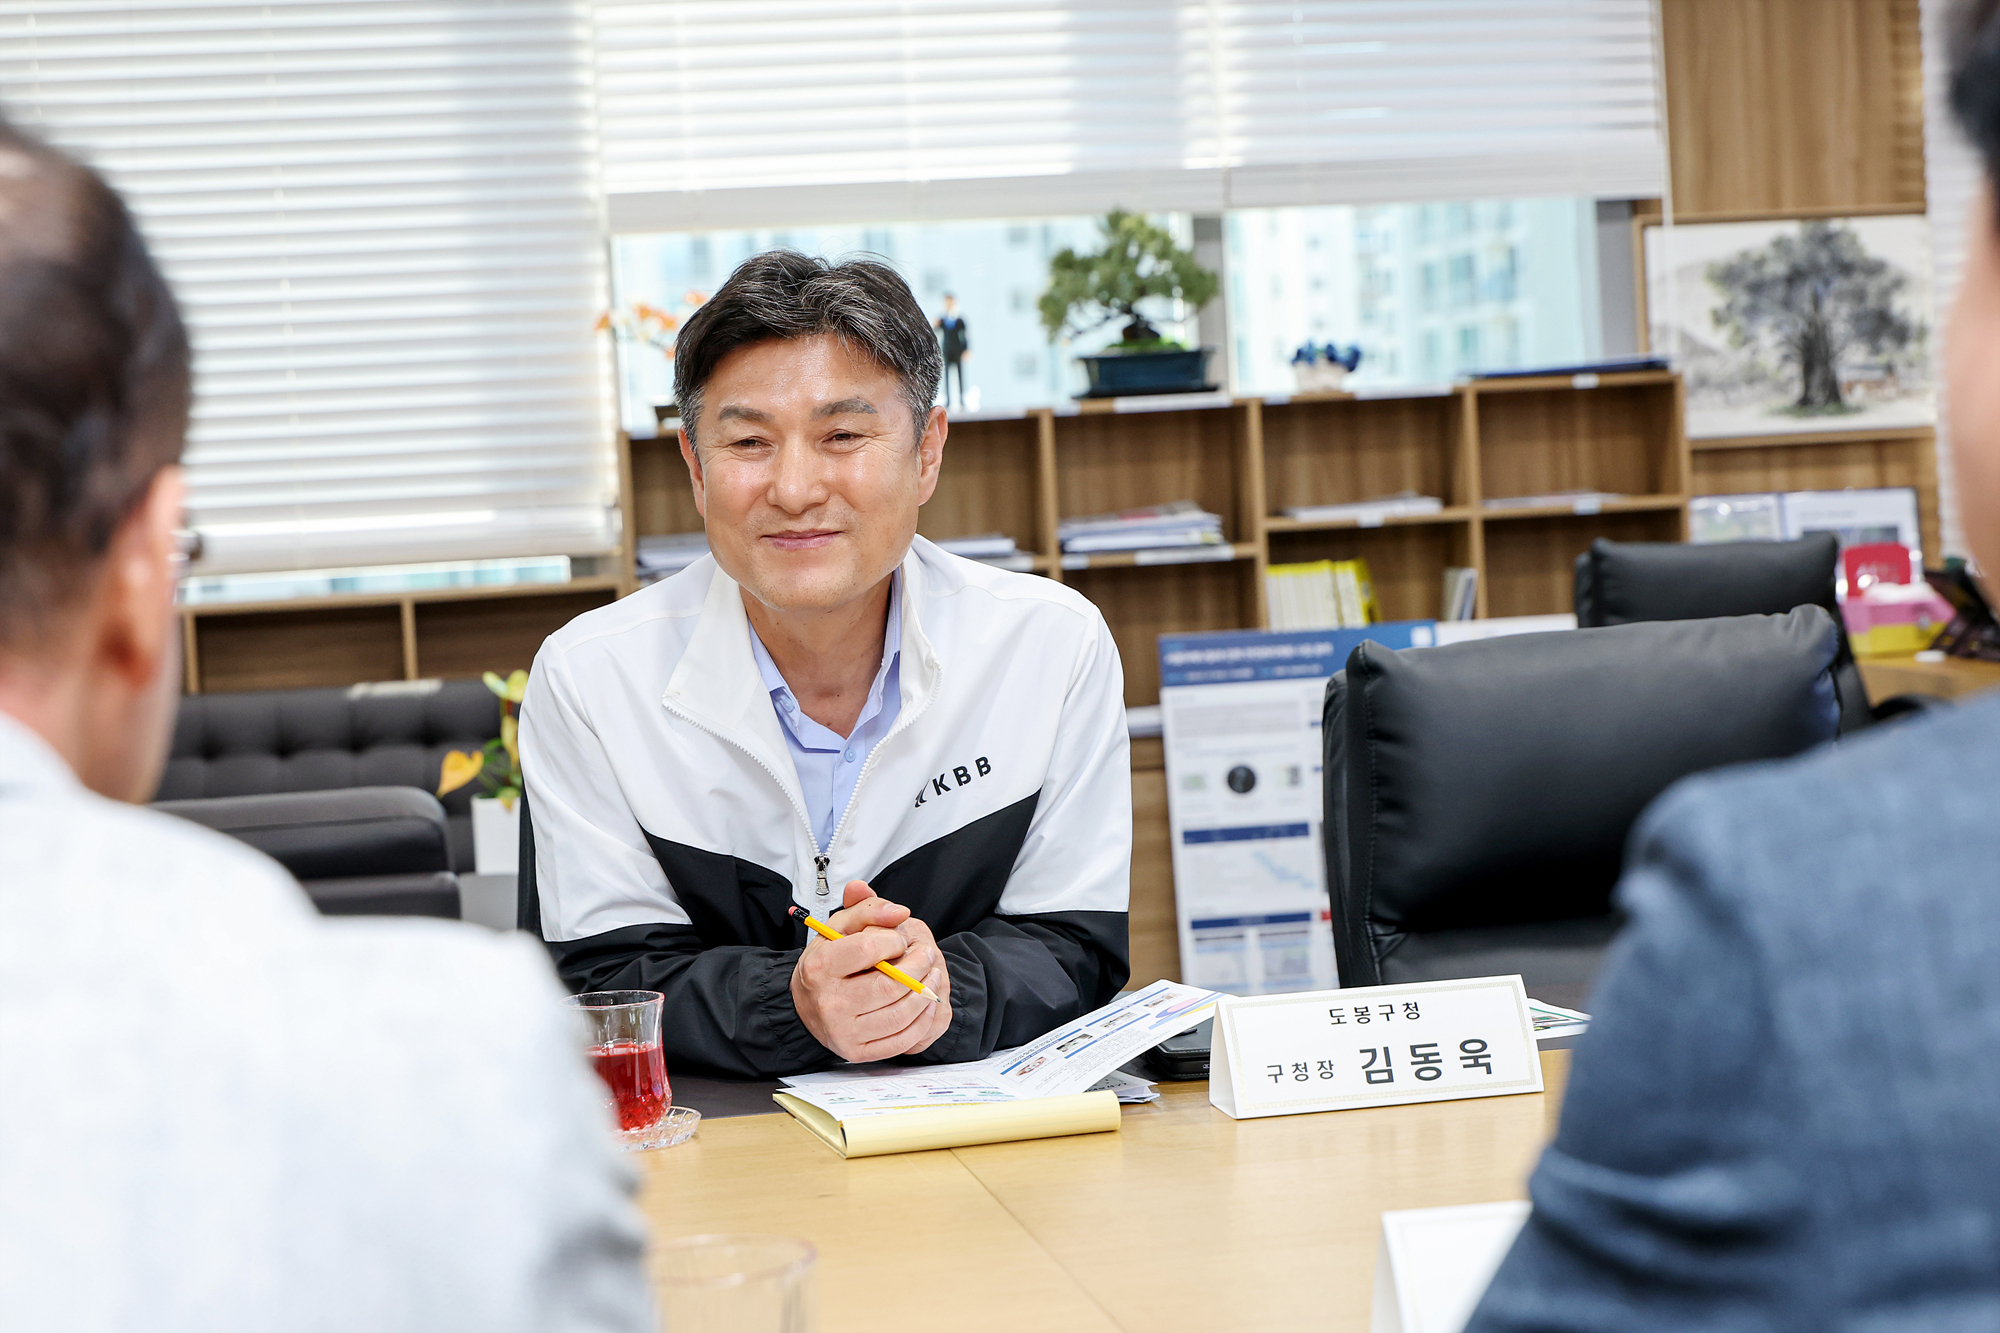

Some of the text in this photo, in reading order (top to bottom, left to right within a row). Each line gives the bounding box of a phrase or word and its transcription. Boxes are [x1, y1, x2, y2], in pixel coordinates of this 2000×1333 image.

[932, 756, 992, 797] KBB
[1329, 1001, 1421, 1025] 도봉구청
[1267, 1038, 1492, 1085] 구청장 김동욱
